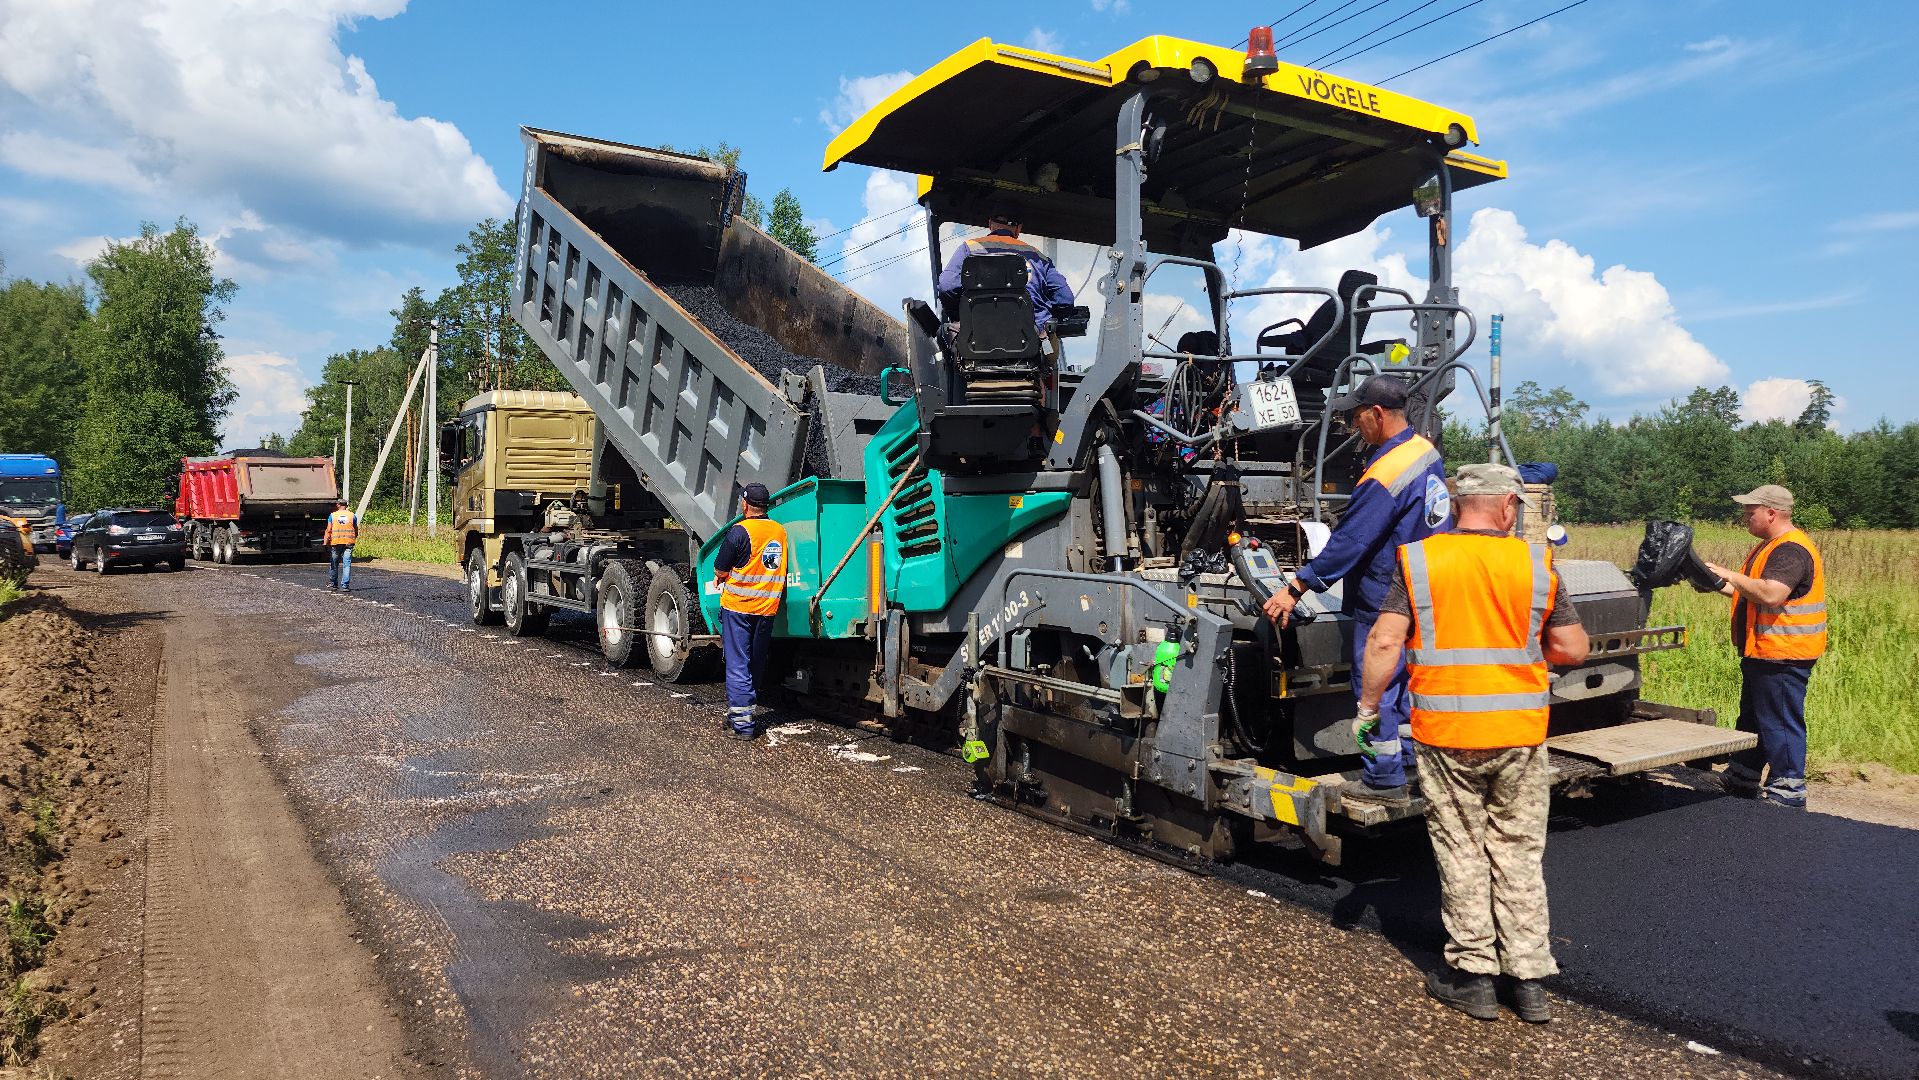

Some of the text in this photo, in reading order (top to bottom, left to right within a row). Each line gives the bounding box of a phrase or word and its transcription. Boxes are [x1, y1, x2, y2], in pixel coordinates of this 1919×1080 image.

[1297, 72, 1381, 113] VÖGELE
[516, 170, 532, 292] SHACMAN
[1256, 383, 1289, 403] 1624
[1281, 405, 1295, 419] 50
[787, 571, 801, 588] ELE
[960, 590, 1029, 663] SER 100-3
